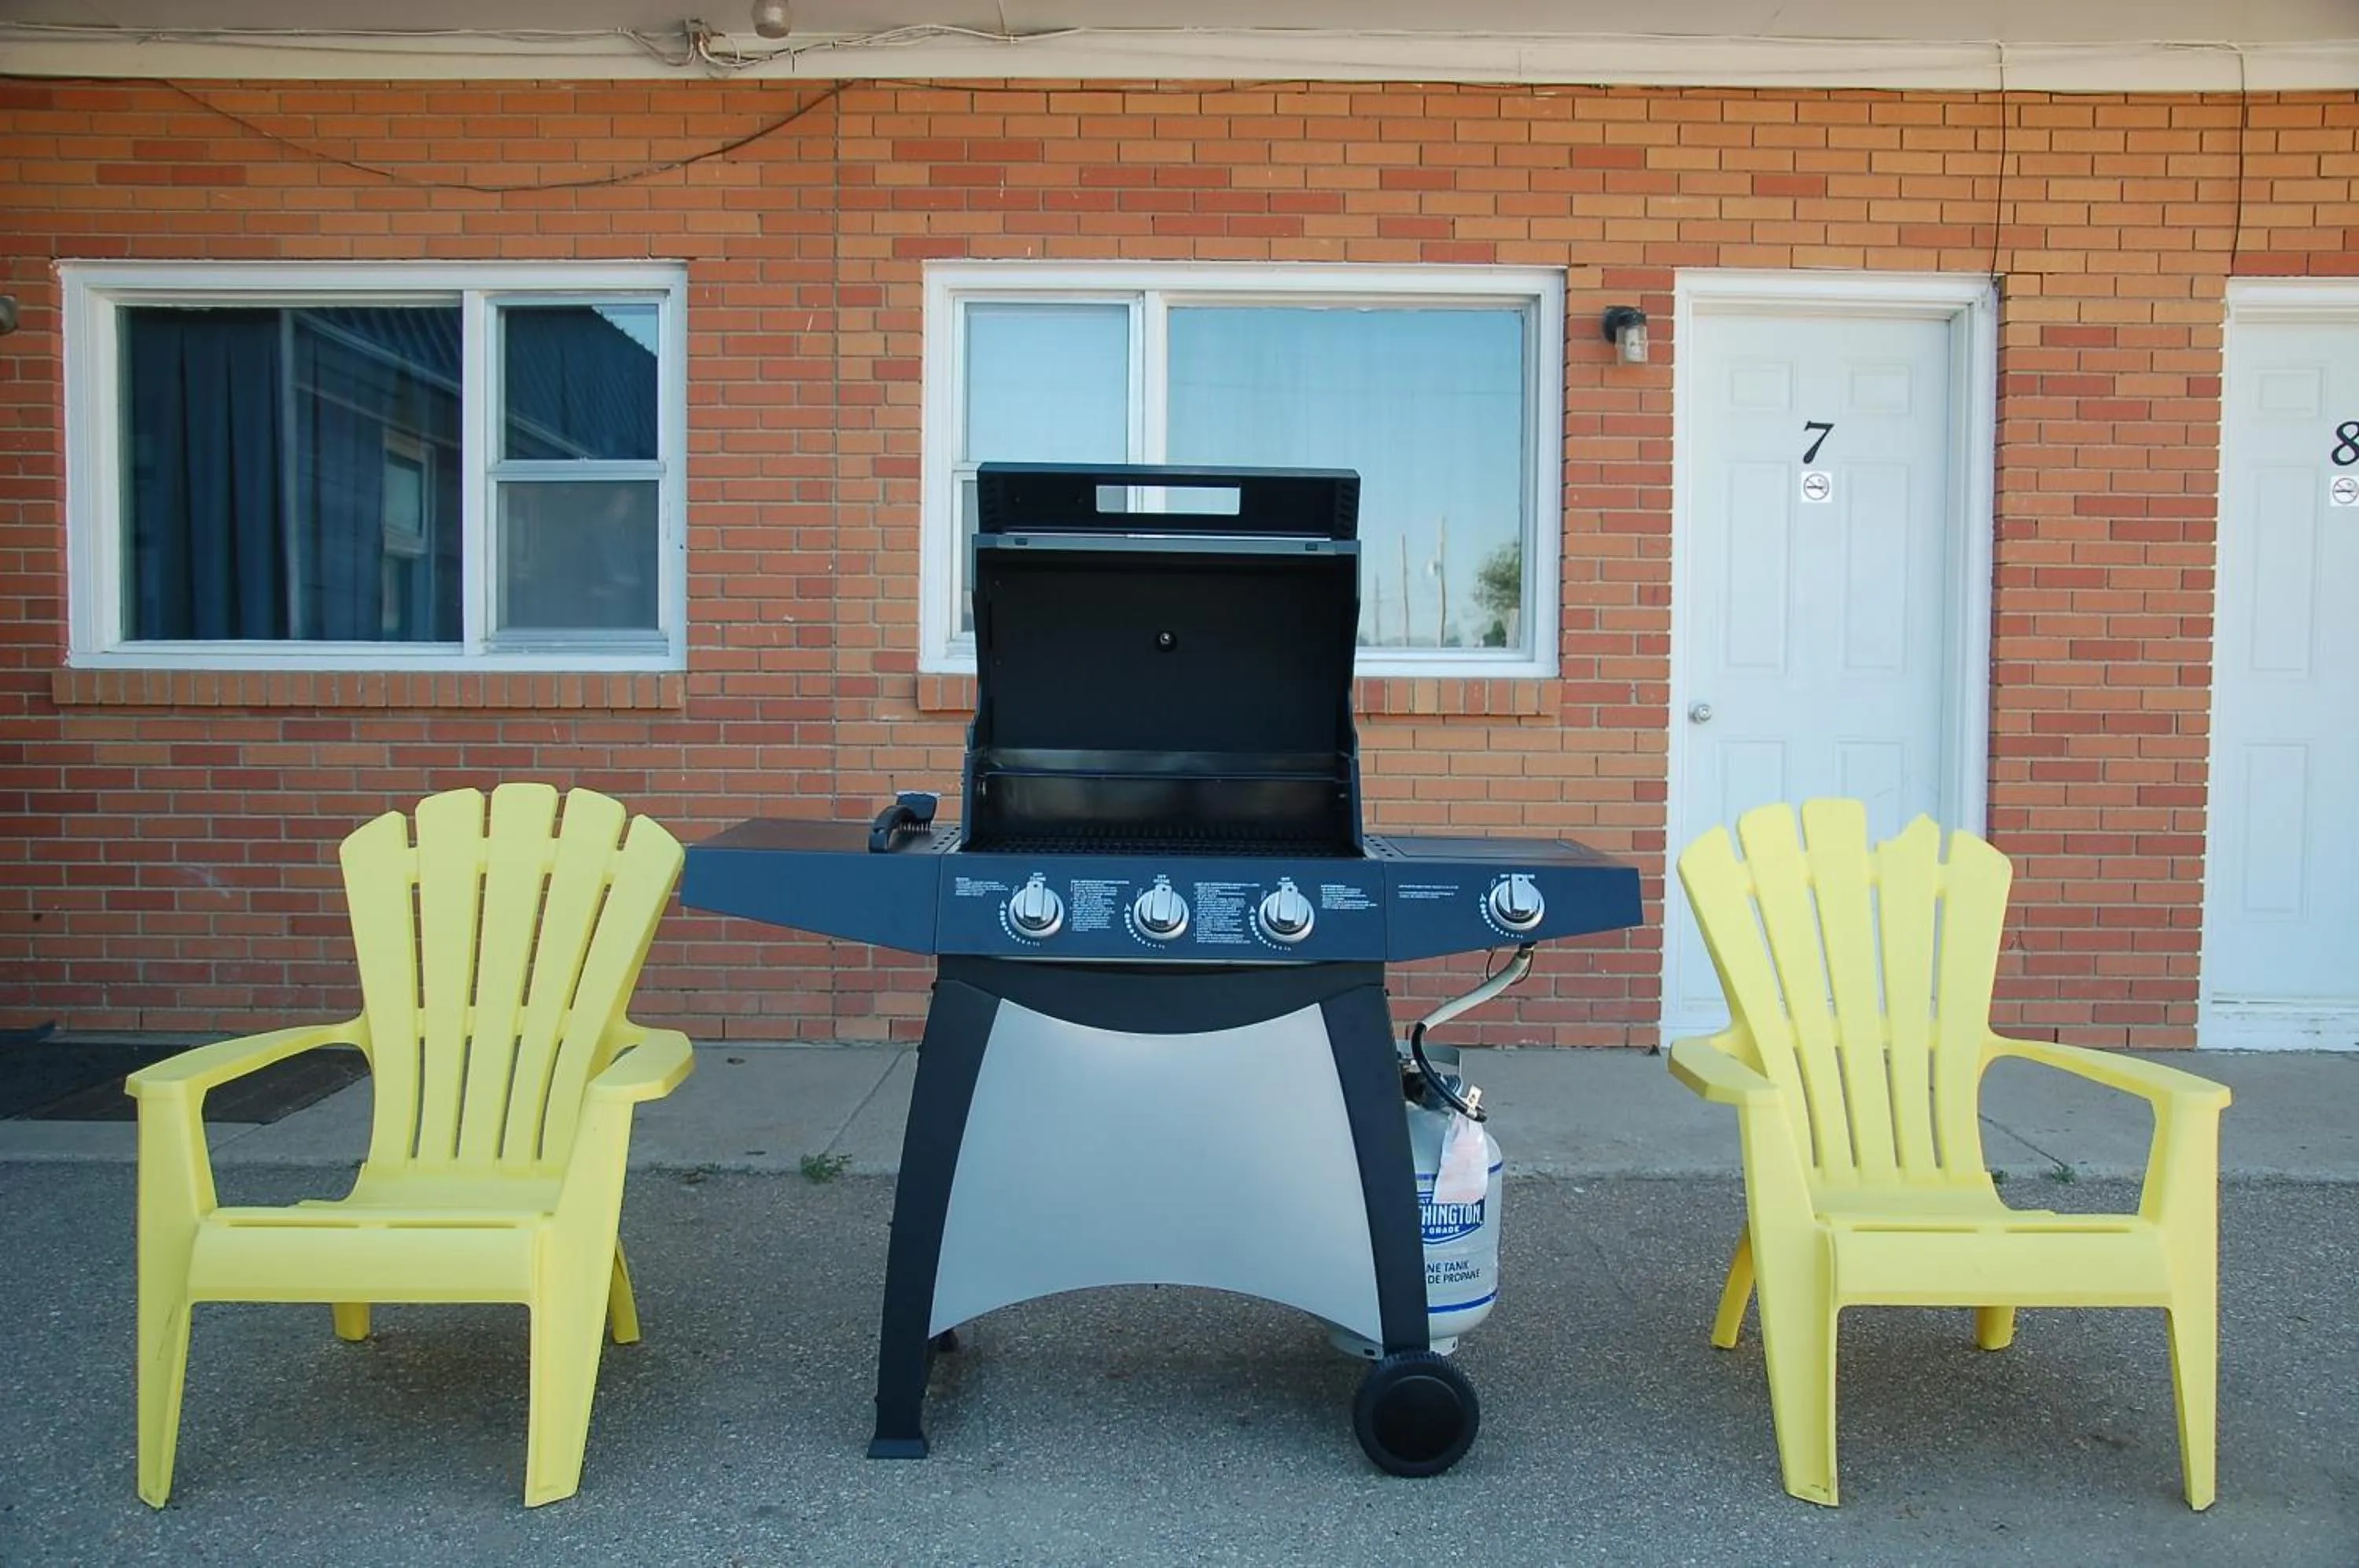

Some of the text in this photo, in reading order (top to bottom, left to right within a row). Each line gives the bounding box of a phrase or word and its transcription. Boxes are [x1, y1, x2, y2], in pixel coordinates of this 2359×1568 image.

[1803, 420, 1835, 464] 7
[2331, 421, 2359, 466] 8
[1427, 1268, 1481, 1284] DE PROPANE
[1444, 1260, 1469, 1272] TANK
